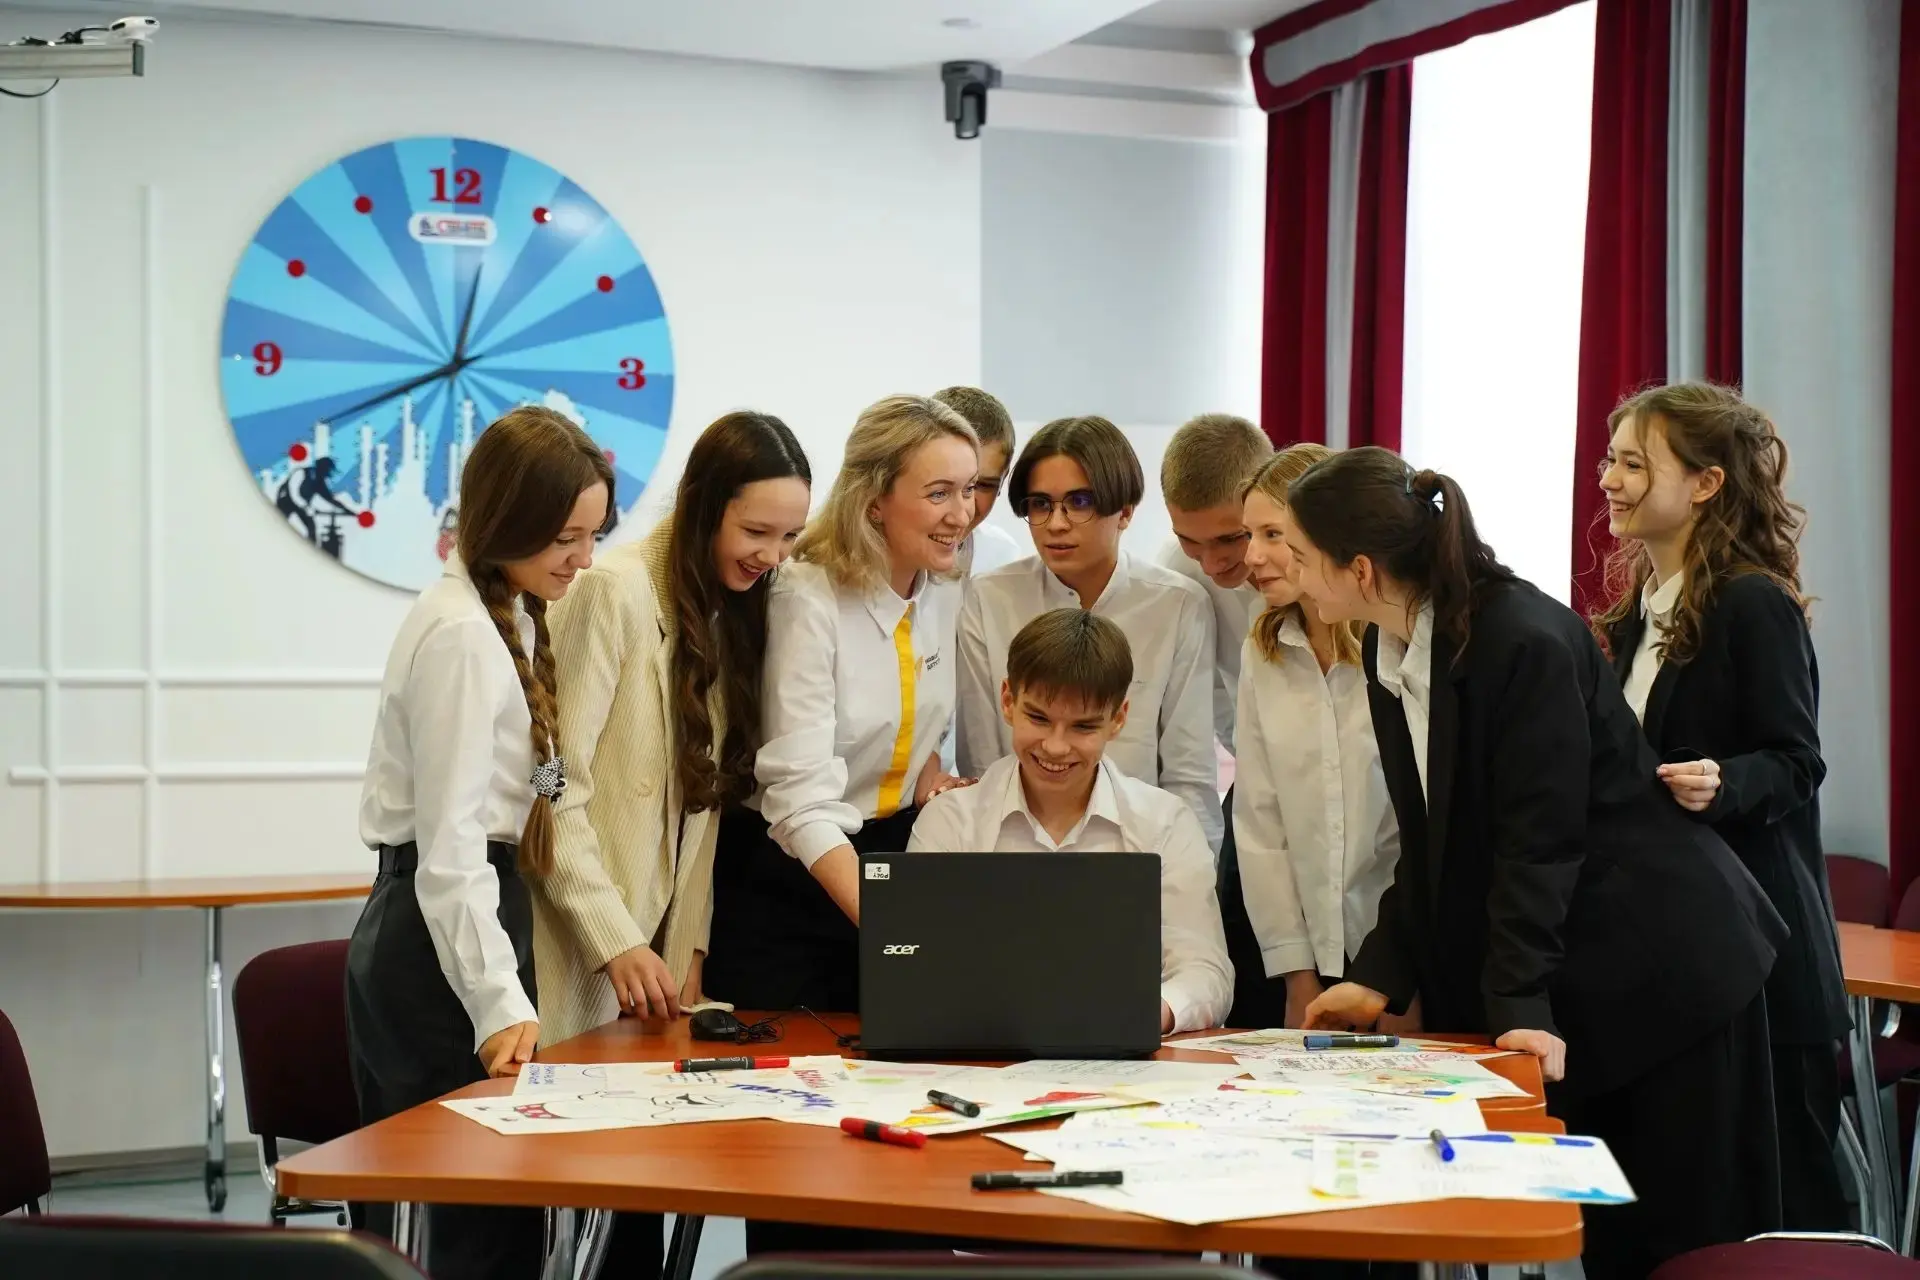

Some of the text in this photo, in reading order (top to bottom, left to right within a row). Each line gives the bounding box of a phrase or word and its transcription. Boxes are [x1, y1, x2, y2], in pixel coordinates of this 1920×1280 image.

[429, 167, 482, 204] 12
[252, 341, 283, 377] 9
[618, 357, 646, 390] 3
[883, 944, 920, 955] acer
